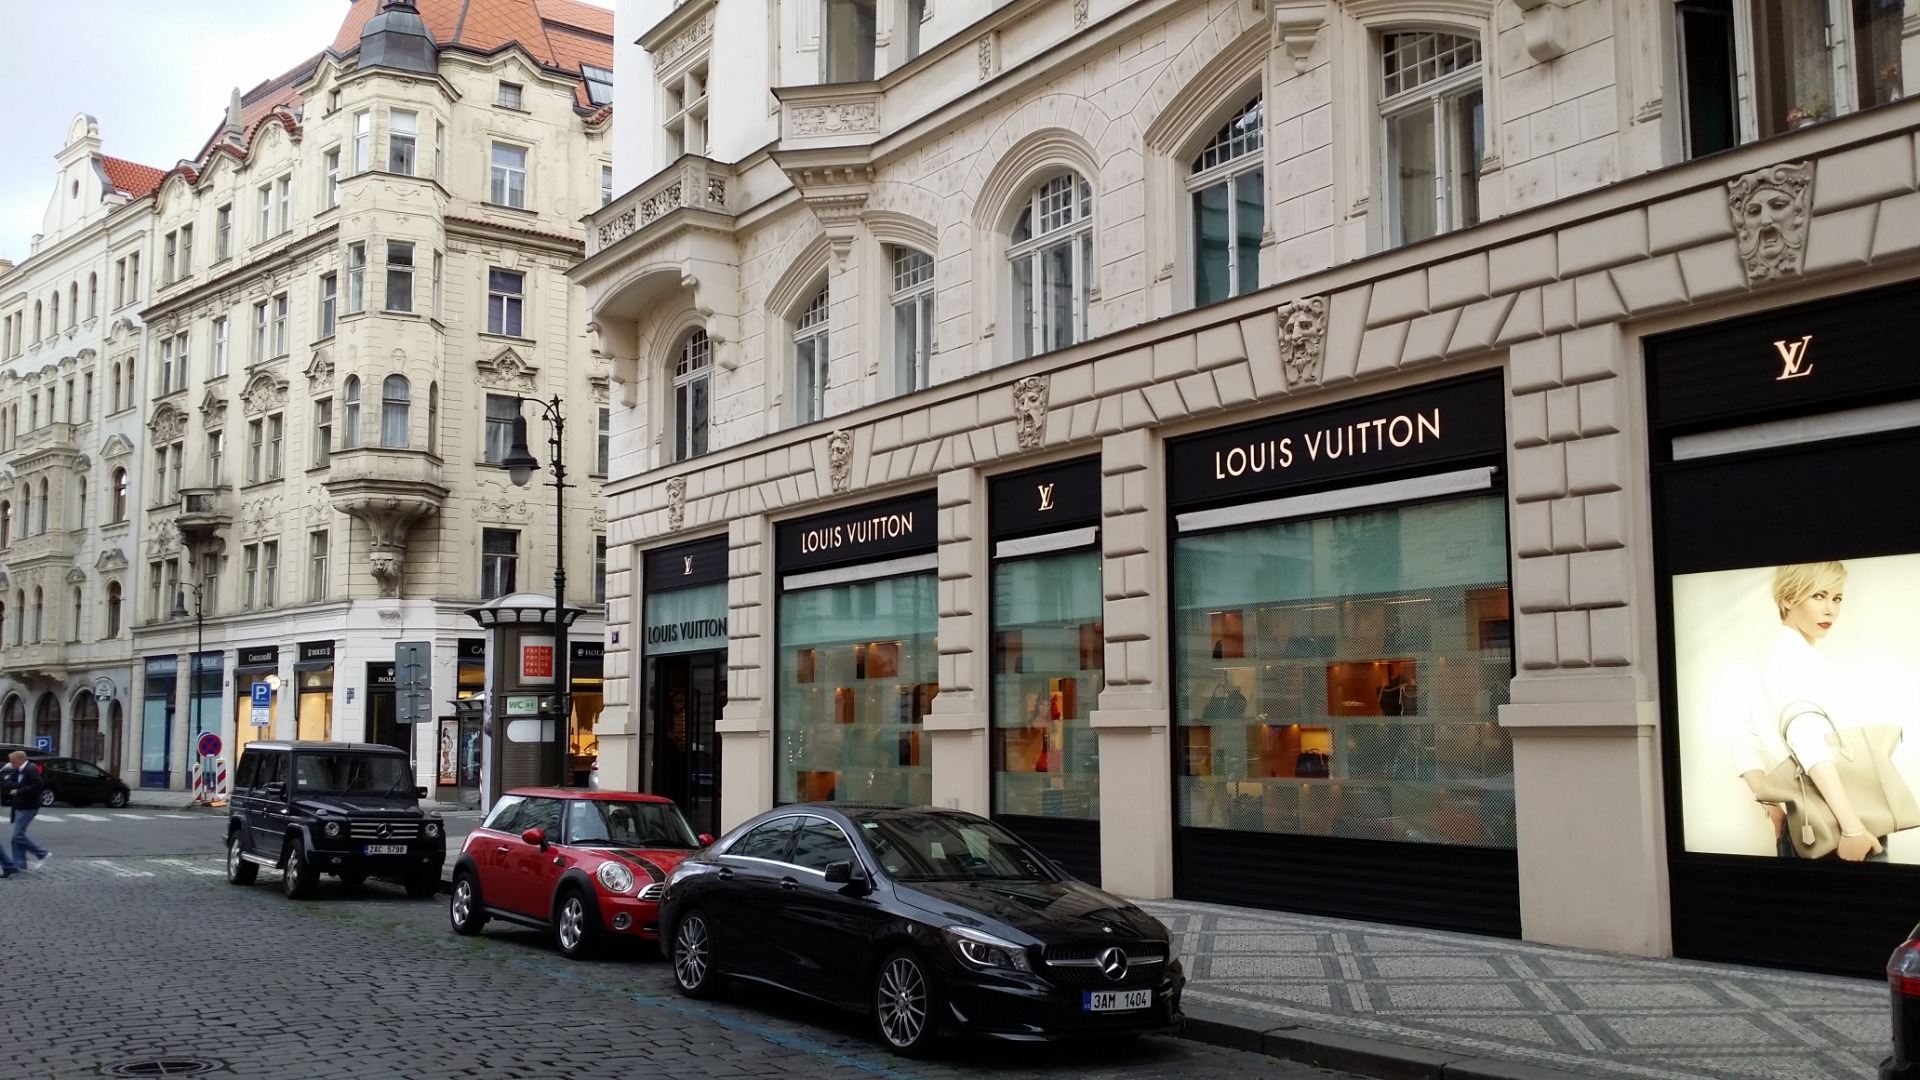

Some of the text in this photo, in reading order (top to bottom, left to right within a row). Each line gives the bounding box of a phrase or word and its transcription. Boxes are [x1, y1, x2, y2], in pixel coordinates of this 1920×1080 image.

[1215, 408, 1441, 480] LOUIS VUITTON
[802, 511, 913, 554] LOUIS VUITTON
[648, 617, 728, 644] LOUIS VUITTON
[255, 685, 268, 700] P
[508, 701, 523, 709] WC
[37, 739, 48, 750] P
[1093, 991, 1147, 1009] 3AM 1404
